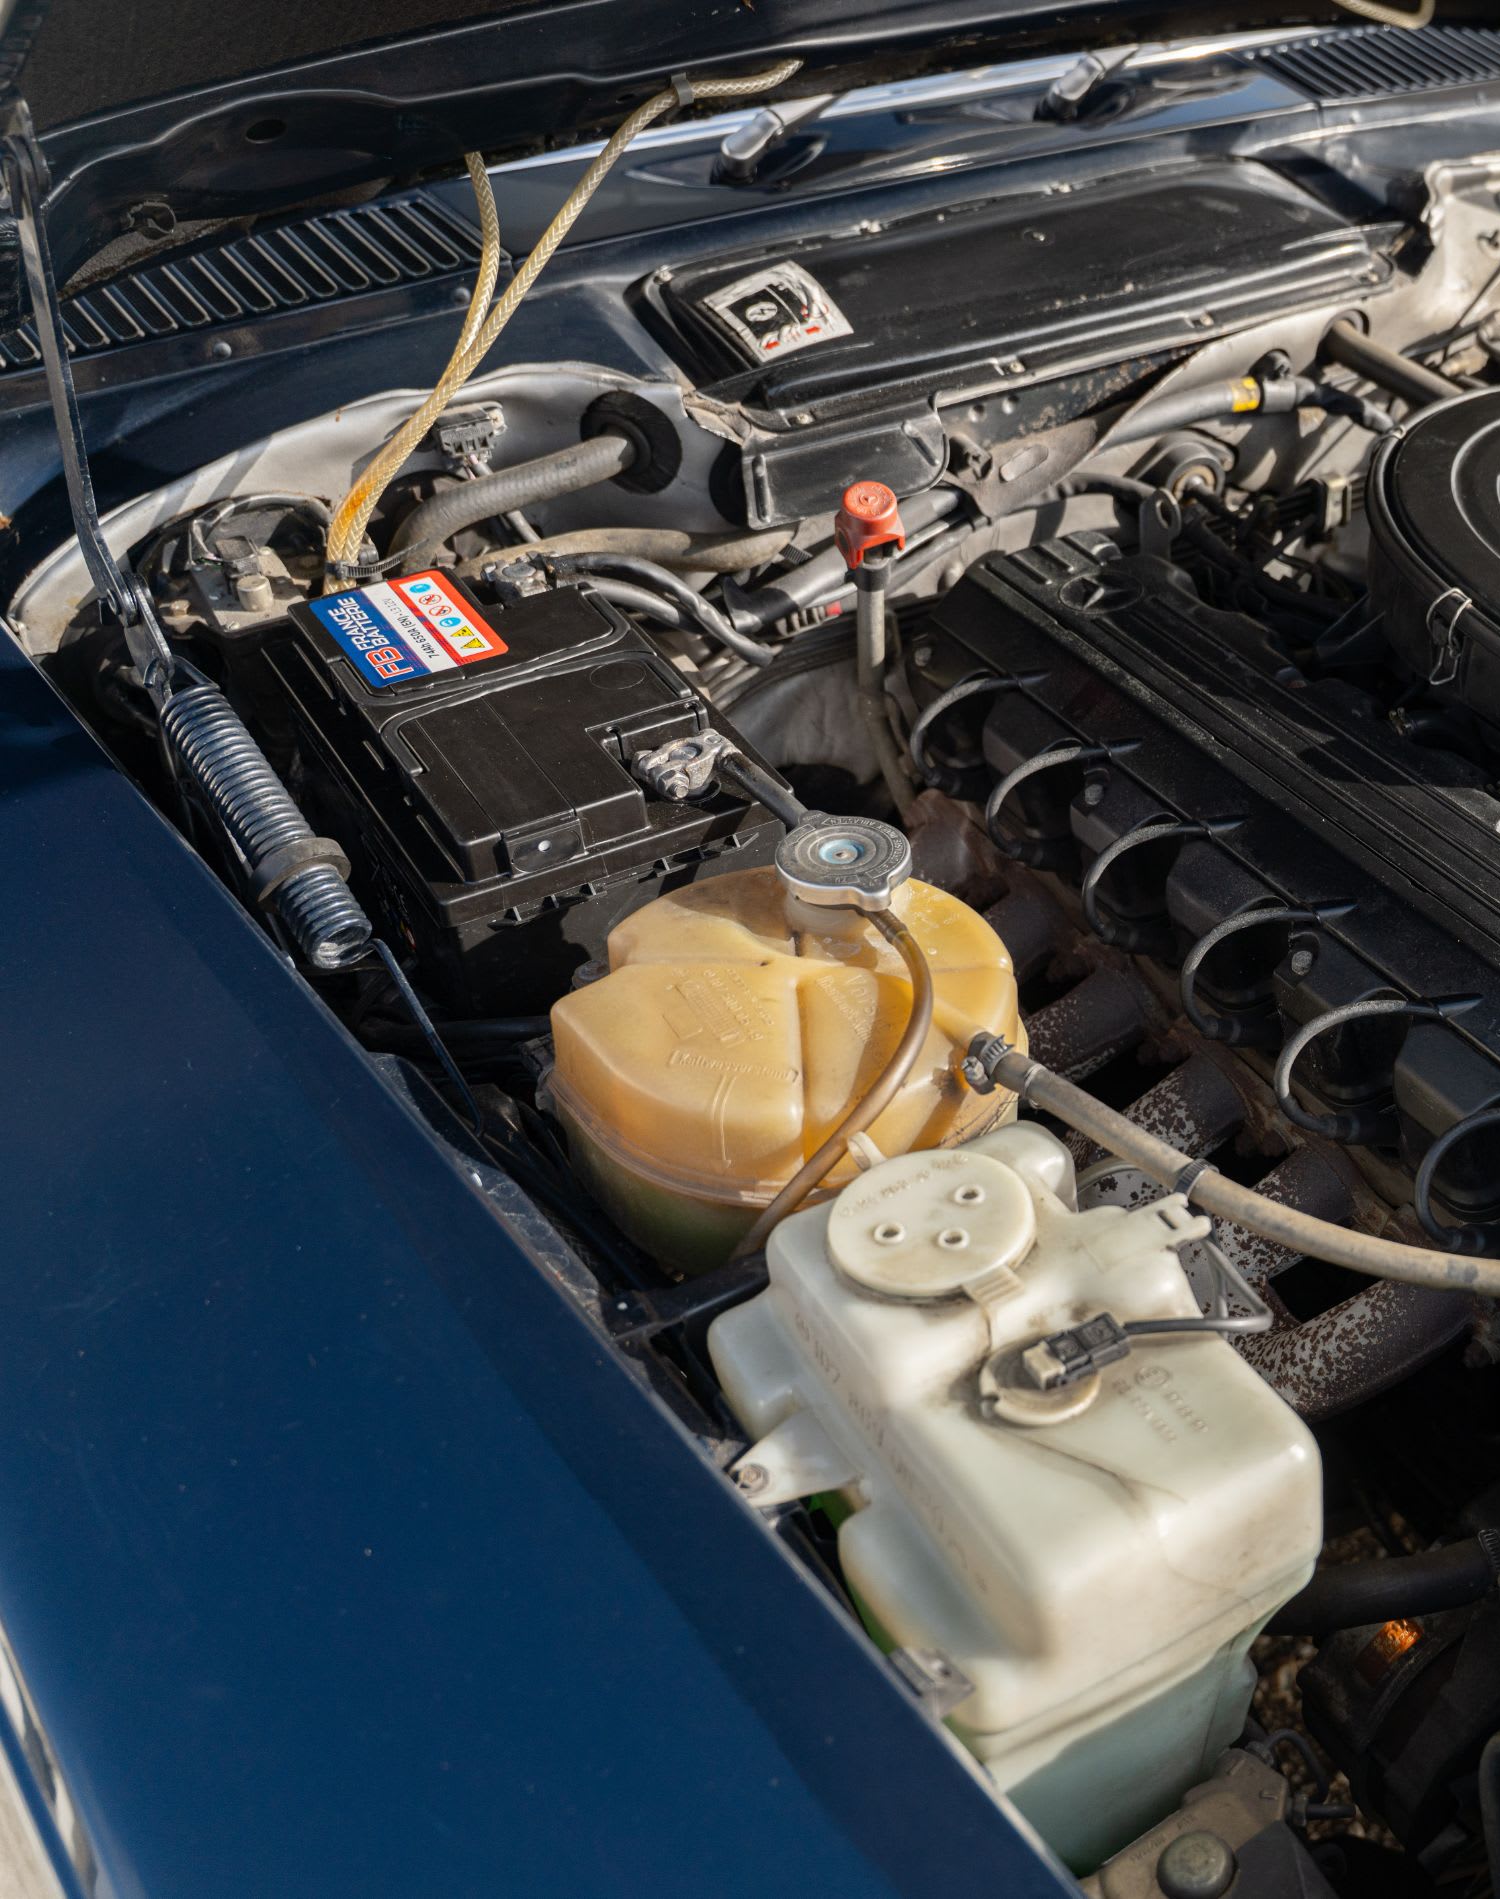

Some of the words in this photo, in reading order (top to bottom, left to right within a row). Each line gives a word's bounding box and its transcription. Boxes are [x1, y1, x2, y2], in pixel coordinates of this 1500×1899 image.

[328, 609, 374, 652] FRANCE
[338, 597, 391, 649] BATTERIE
[407, 626, 426, 643] 650A
[365, 646, 415, 680] FB
